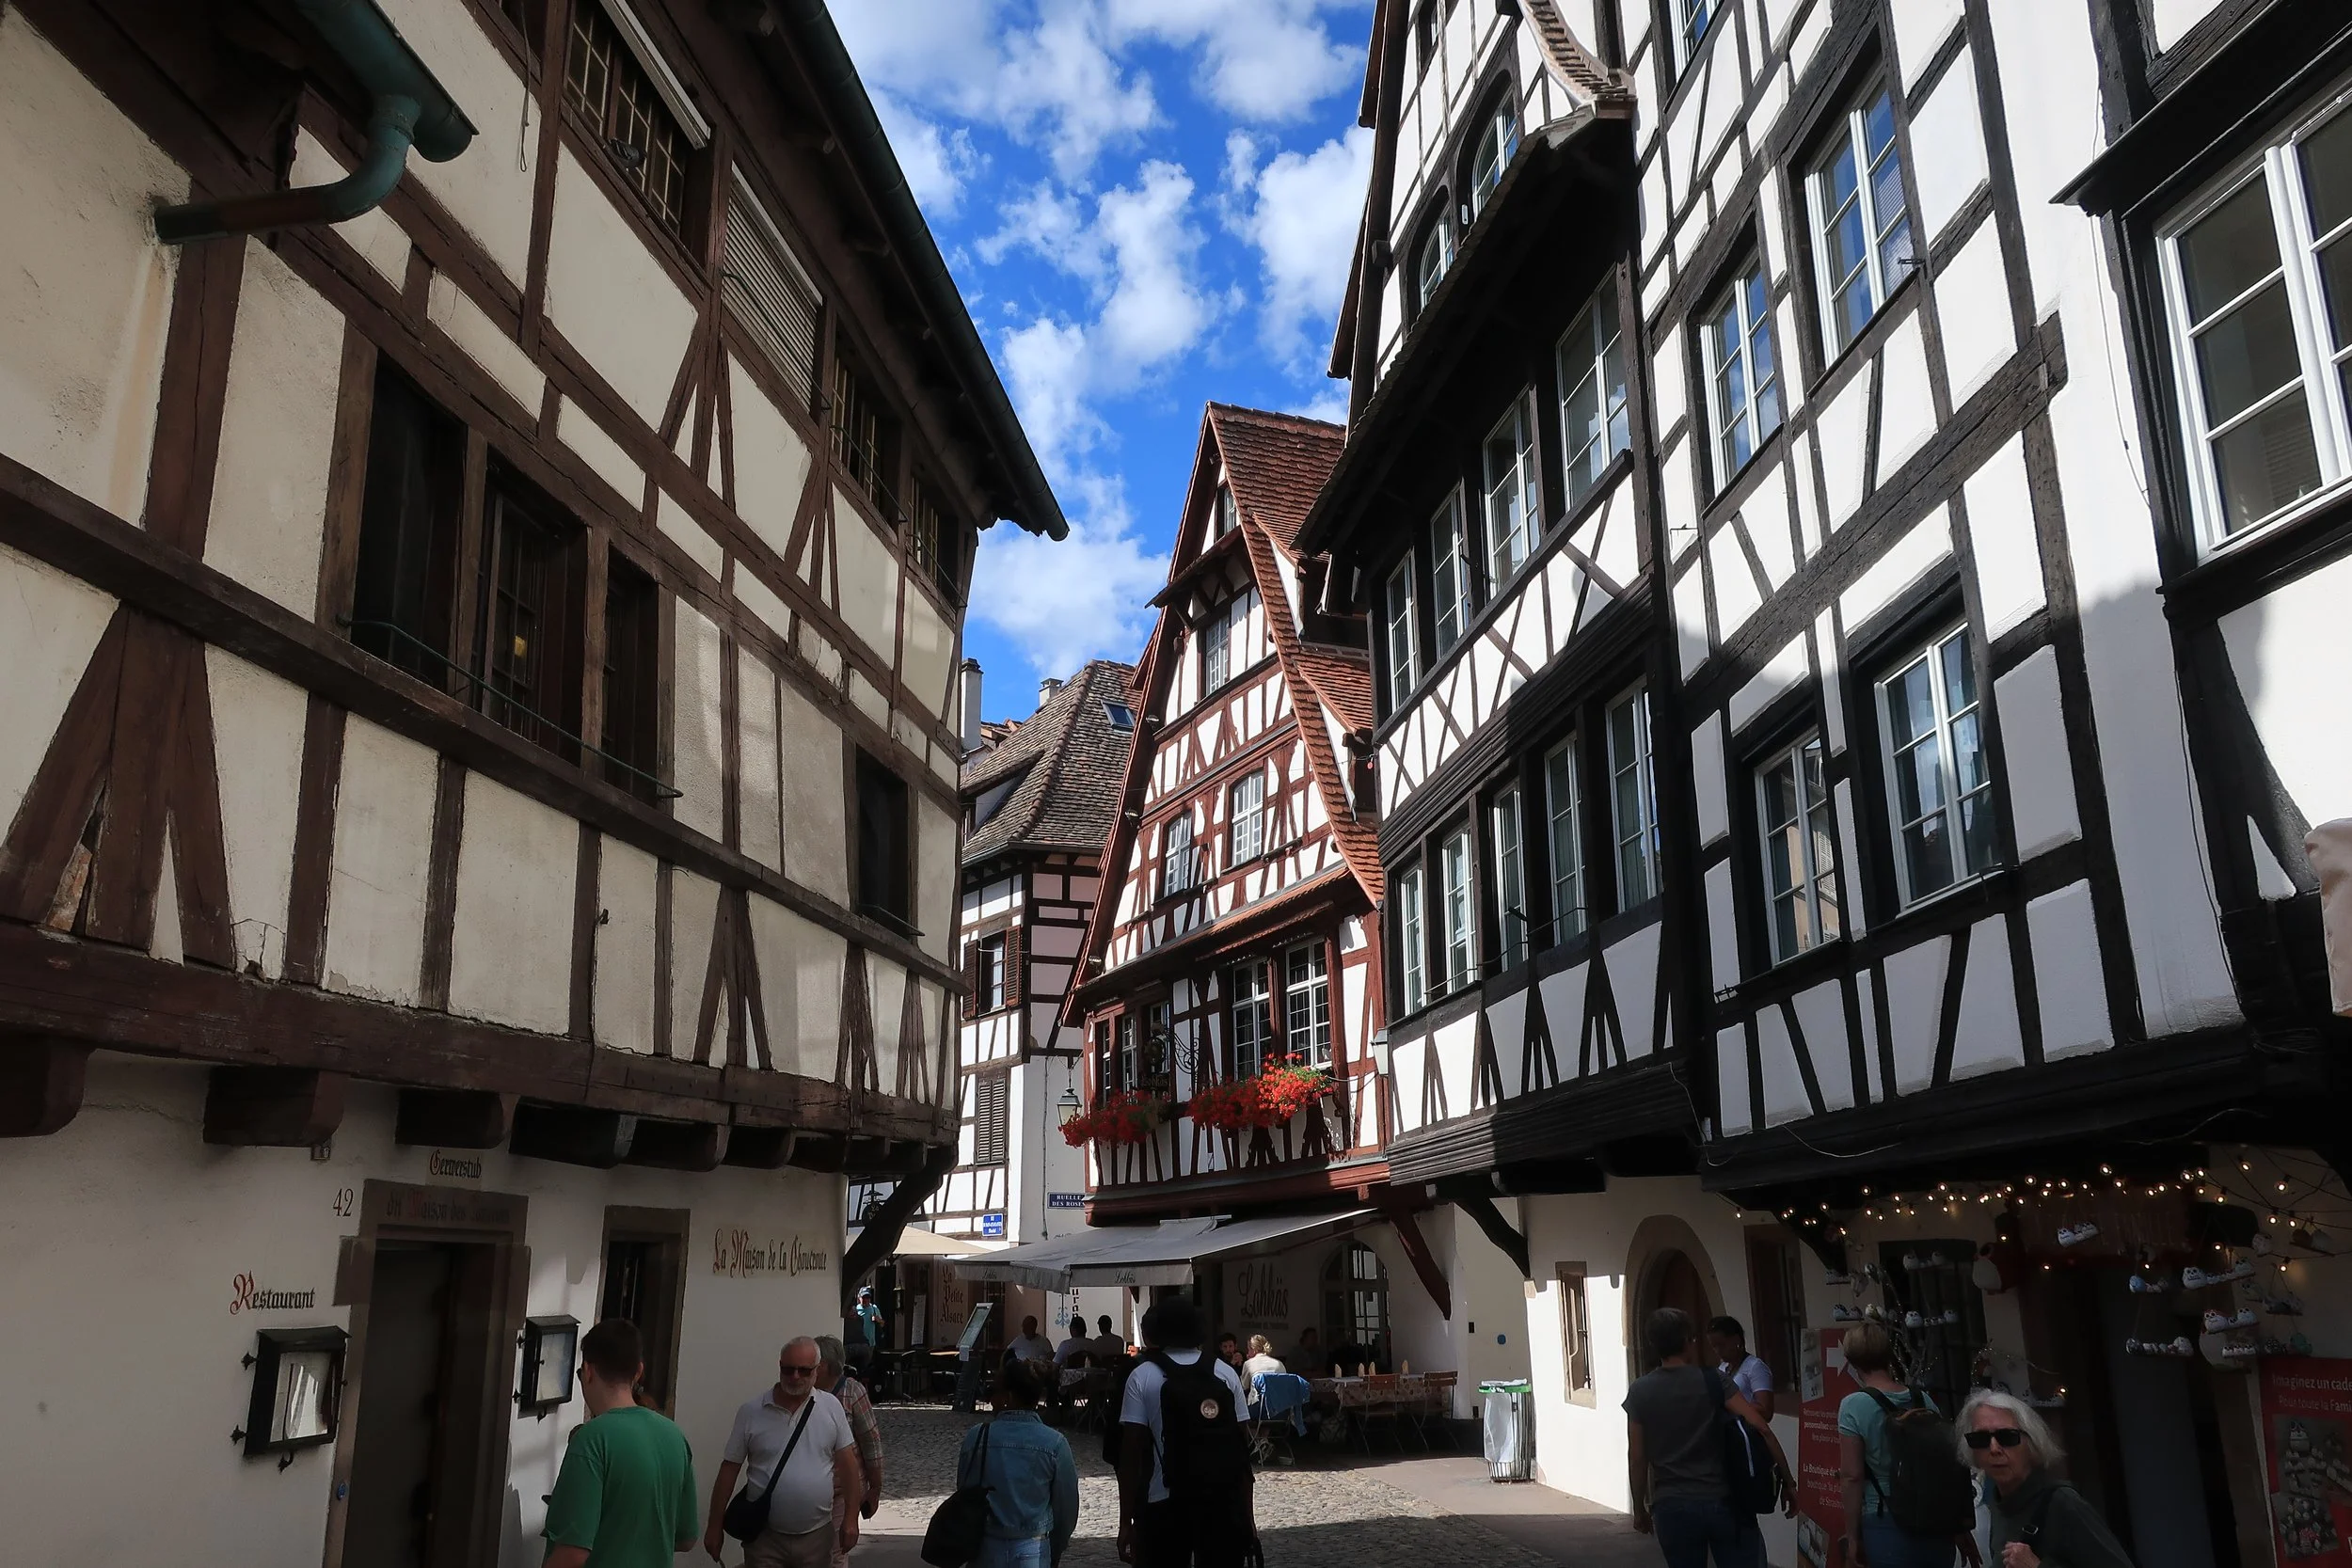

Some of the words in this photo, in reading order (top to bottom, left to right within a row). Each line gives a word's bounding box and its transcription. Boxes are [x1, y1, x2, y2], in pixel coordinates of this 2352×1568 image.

[333, 1188, 354, 1217] 42
[730, 1228, 765, 1278] Maison
[230, 1269, 315, 1316] Restaurant
[2272, 1372, 2316, 1391] Imaginez
[2316, 1378, 2330, 1389] un
